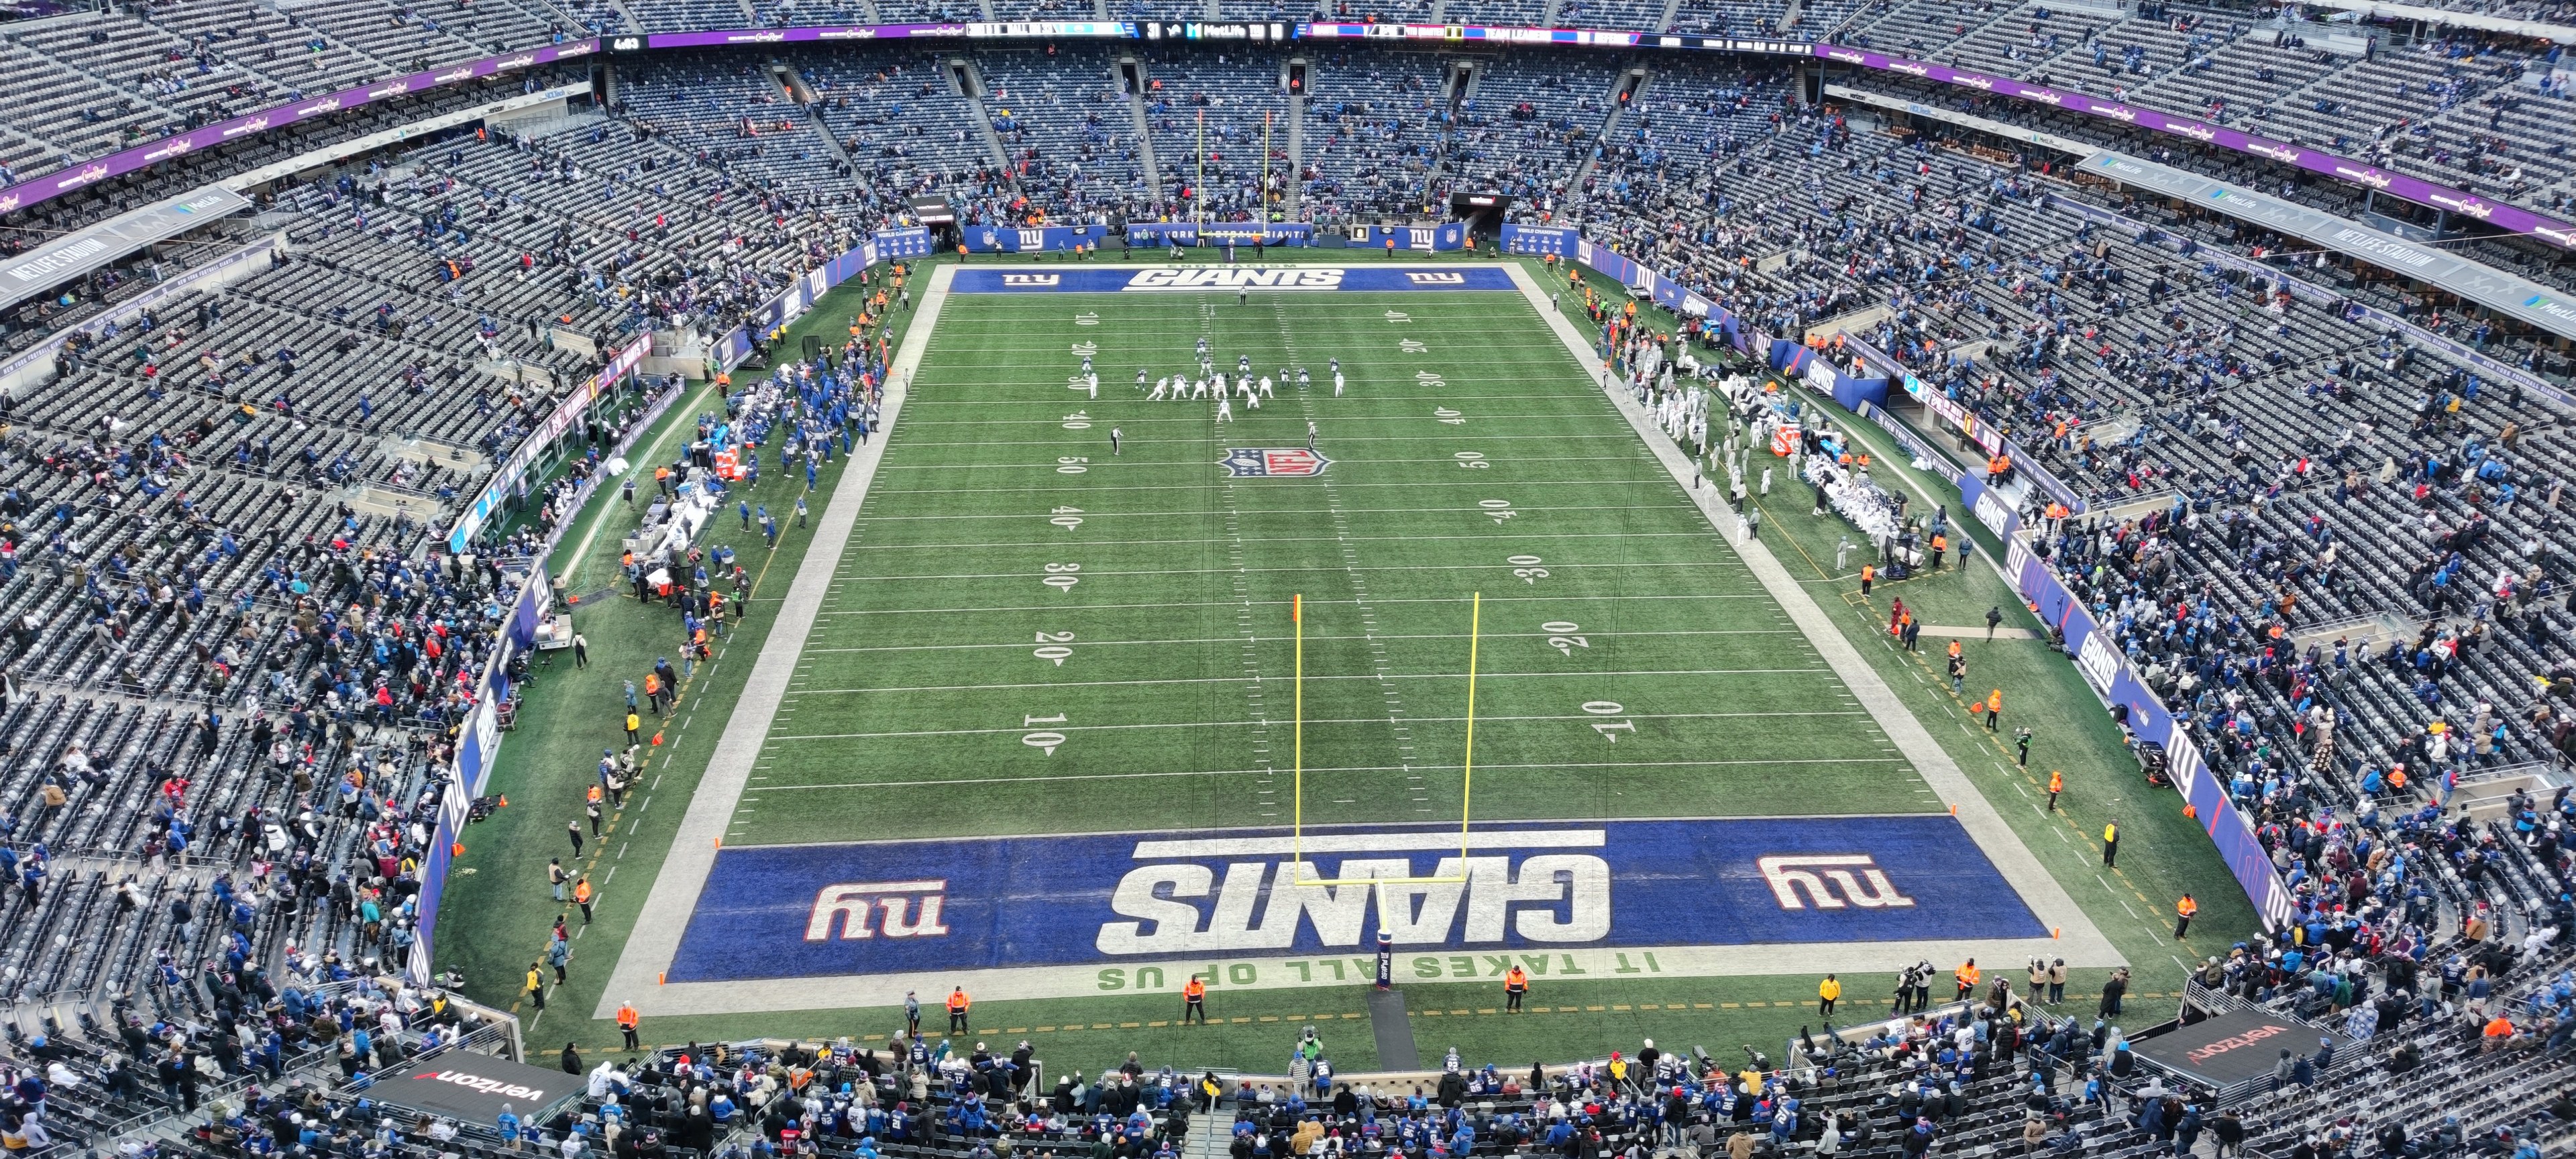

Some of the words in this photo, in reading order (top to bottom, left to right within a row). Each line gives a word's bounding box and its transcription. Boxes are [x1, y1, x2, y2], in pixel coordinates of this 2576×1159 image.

[1147, 23, 1160, 38] 31
[1204, 25, 1246, 36] MetLife
[1485, 28, 1511, 39] TEAM
[2114, 162, 2143, 175] MetLife
[187, 195, 223, 211] MetLife
[2223, 193, 2257, 209] MetLife
[1018, 230, 1043, 247] ny
[1165, 231, 1195, 239] YORK
[1357, 229, 1364, 239] 8
[1410, 229, 1434, 245] ny
[864, 242, 876, 264] ny
[1578, 239, 1593, 262] ny
[2333, 228, 2379, 250] METLIFE
[2377, 241, 2436, 267] STADIUM
[7, 254, 60, 282] METLIFE
[56, 237, 109, 266] STADIUM
[808, 267, 826, 295] ny
[1002, 274, 1059, 286] ny
[1128, 268, 1345, 287] GIANTS
[1405, 272, 1465, 284] ny
[784, 288, 801, 313] GIANTS
[1682, 294, 1709, 317] GIANTS
[1075, 314, 1099, 325] 10
[1384, 313, 1412, 323] 10
[2539, 302, 2576, 325] MetLi
[2407, 325, 2432, 342] FOOTBALL
[2432, 337, 2452, 351] GIANTS
[28, 345, 50, 361] FOOTBALL
[720, 337, 733, 364] ny
[1071, 343, 1097, 355] 20
[1399, 341, 1428, 353] 20
[1415, 373, 1446, 387] 30
[1807, 359, 1837, 393] GIANTS
[2512, 372, 2540, 391] FOOTBALL
[2540, 386, 2562, 400] GIANTS
[644, 406, 664, 429] FOOTBALL
[1062, 413, 1091, 429] 40
[1434, 410, 1466, 425] 40
[1884, 419, 1894, 433] NEW
[1895, 427, 1907, 441] YORK
[1907, 437, 1932, 461] FOOTBALL
[1932, 457, 1951, 478] GIANTS
[1057, 457, 1088, 474] 50
[1265, 450, 1320, 474] NFL
[1454, 451, 1490, 468] 50
[2015, 454, 2024, 467] NEW
[2023, 461, 2035, 476] YORK
[2035, 471, 2055, 493] FOOTBALL
[2055, 486, 2072, 505] GIANTS
[561, 503, 580, 531] FOOTBALL
[580, 482, 595, 505] GIANTS
[1479, 500, 1517, 519] 40
[1974, 492, 2008, 537] GIANTS
[1050, 506, 1085, 526] 40
[1507, 555, 1550, 578] 30
[2006, 537, 2028, 582] ny
[1042, 562, 1081, 586] 30
[1541, 621, 1590, 648] 20
[1033, 631, 1075, 659] 20
[2081, 630, 2118, 689] GIANTS
[476, 687, 496, 755] GIANTS
[1581, 701, 1637, 734] 10
[1022, 712, 1068, 747] 10
[2167, 721, 2200, 802] ny
[1756, 854, 1915, 910] ny
[803, 879, 949, 942] ny
[1095, 854, 1610, 956] GIANTS
[1285, 957, 1377, 982] ALL
[1415, 952, 1589, 979] TAKES
[1616, 951, 1659, 974] IT
[1097, 966, 1165, 991] US
[1201, 962, 1258, 987] OF
[382, 1022, 391, 1032] 26
[1896, 1027, 1906, 1037] 26
[261, 1037, 270, 1047] 13
[1965, 1036, 1974, 1046] 26
[2186, 1024, 2289, 1060] verizon
[834, 1056, 847, 1066] 56
[914, 1052, 924, 1061] 26
[694, 1071, 704, 1081] 91
[942, 1067, 952, 1078] 26
[1318, 1065, 1329, 1075] 26
[1659, 1068, 1671, 1079] 72
[436, 1070, 544, 1102] verizon
[592, 1074, 600, 1085] 7
[955, 1076, 964, 1085] 17
[1161, 1077, 1171, 1087] 26
[820, 1117, 833, 1125] 92
[1629, 1109, 1635, 1118] 8
[1774, 1110, 1787, 1123] 72
[892, 1120, 901, 1129] 21
[1099, 1122, 1106, 1132] 5
[782, 1140, 794, 1149] 10
[1430, 1134, 1437, 1144] 8
